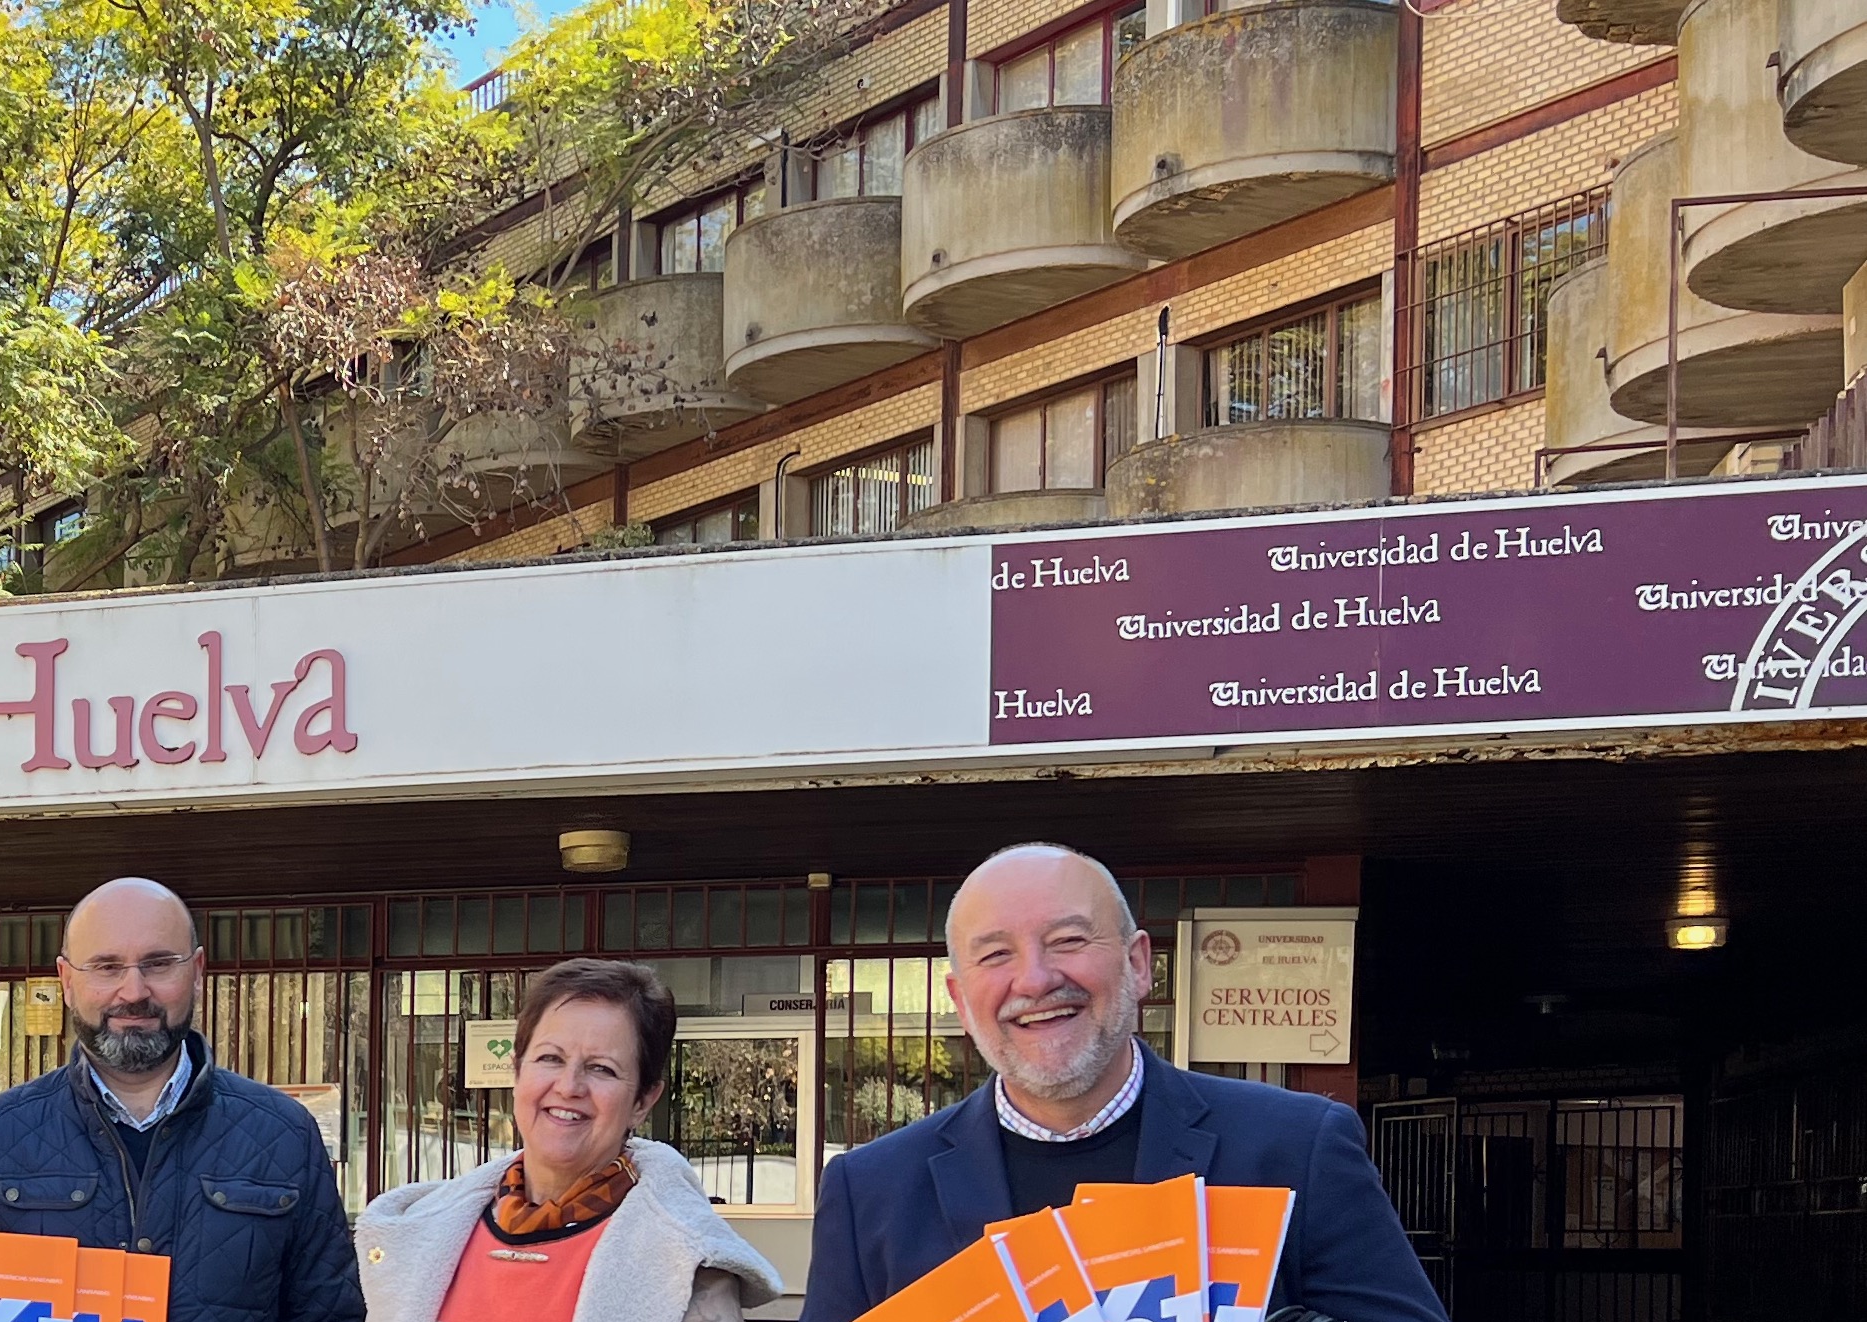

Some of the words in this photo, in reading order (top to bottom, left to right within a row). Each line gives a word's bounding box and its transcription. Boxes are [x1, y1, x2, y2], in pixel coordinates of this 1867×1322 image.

[1267, 533, 1439, 572] Universidad
[1450, 531, 1488, 561] de
[1494, 525, 1604, 558] Huelva
[991, 562, 1025, 590] de
[1030, 555, 1130, 588] Huelva
[1116, 603, 1281, 640] Universidad
[1291, 601, 1328, 631] de
[1334, 596, 1441, 627] Huelva
[1209, 671, 1378, 707] Universidad
[1388, 669, 1427, 700] de
[1432, 665, 1542, 698] Huelva
[994, 688, 1093, 719] Huelva
[1258, 935, 1324, 944] UNIVERSIDAD
[1262, 955, 1273, 965] DE
[1277, 955, 1318, 965] HUELVA
[1211, 988, 1331, 1006] SERVICIOS
[1203, 1008, 1337, 1027] CENTRALES
